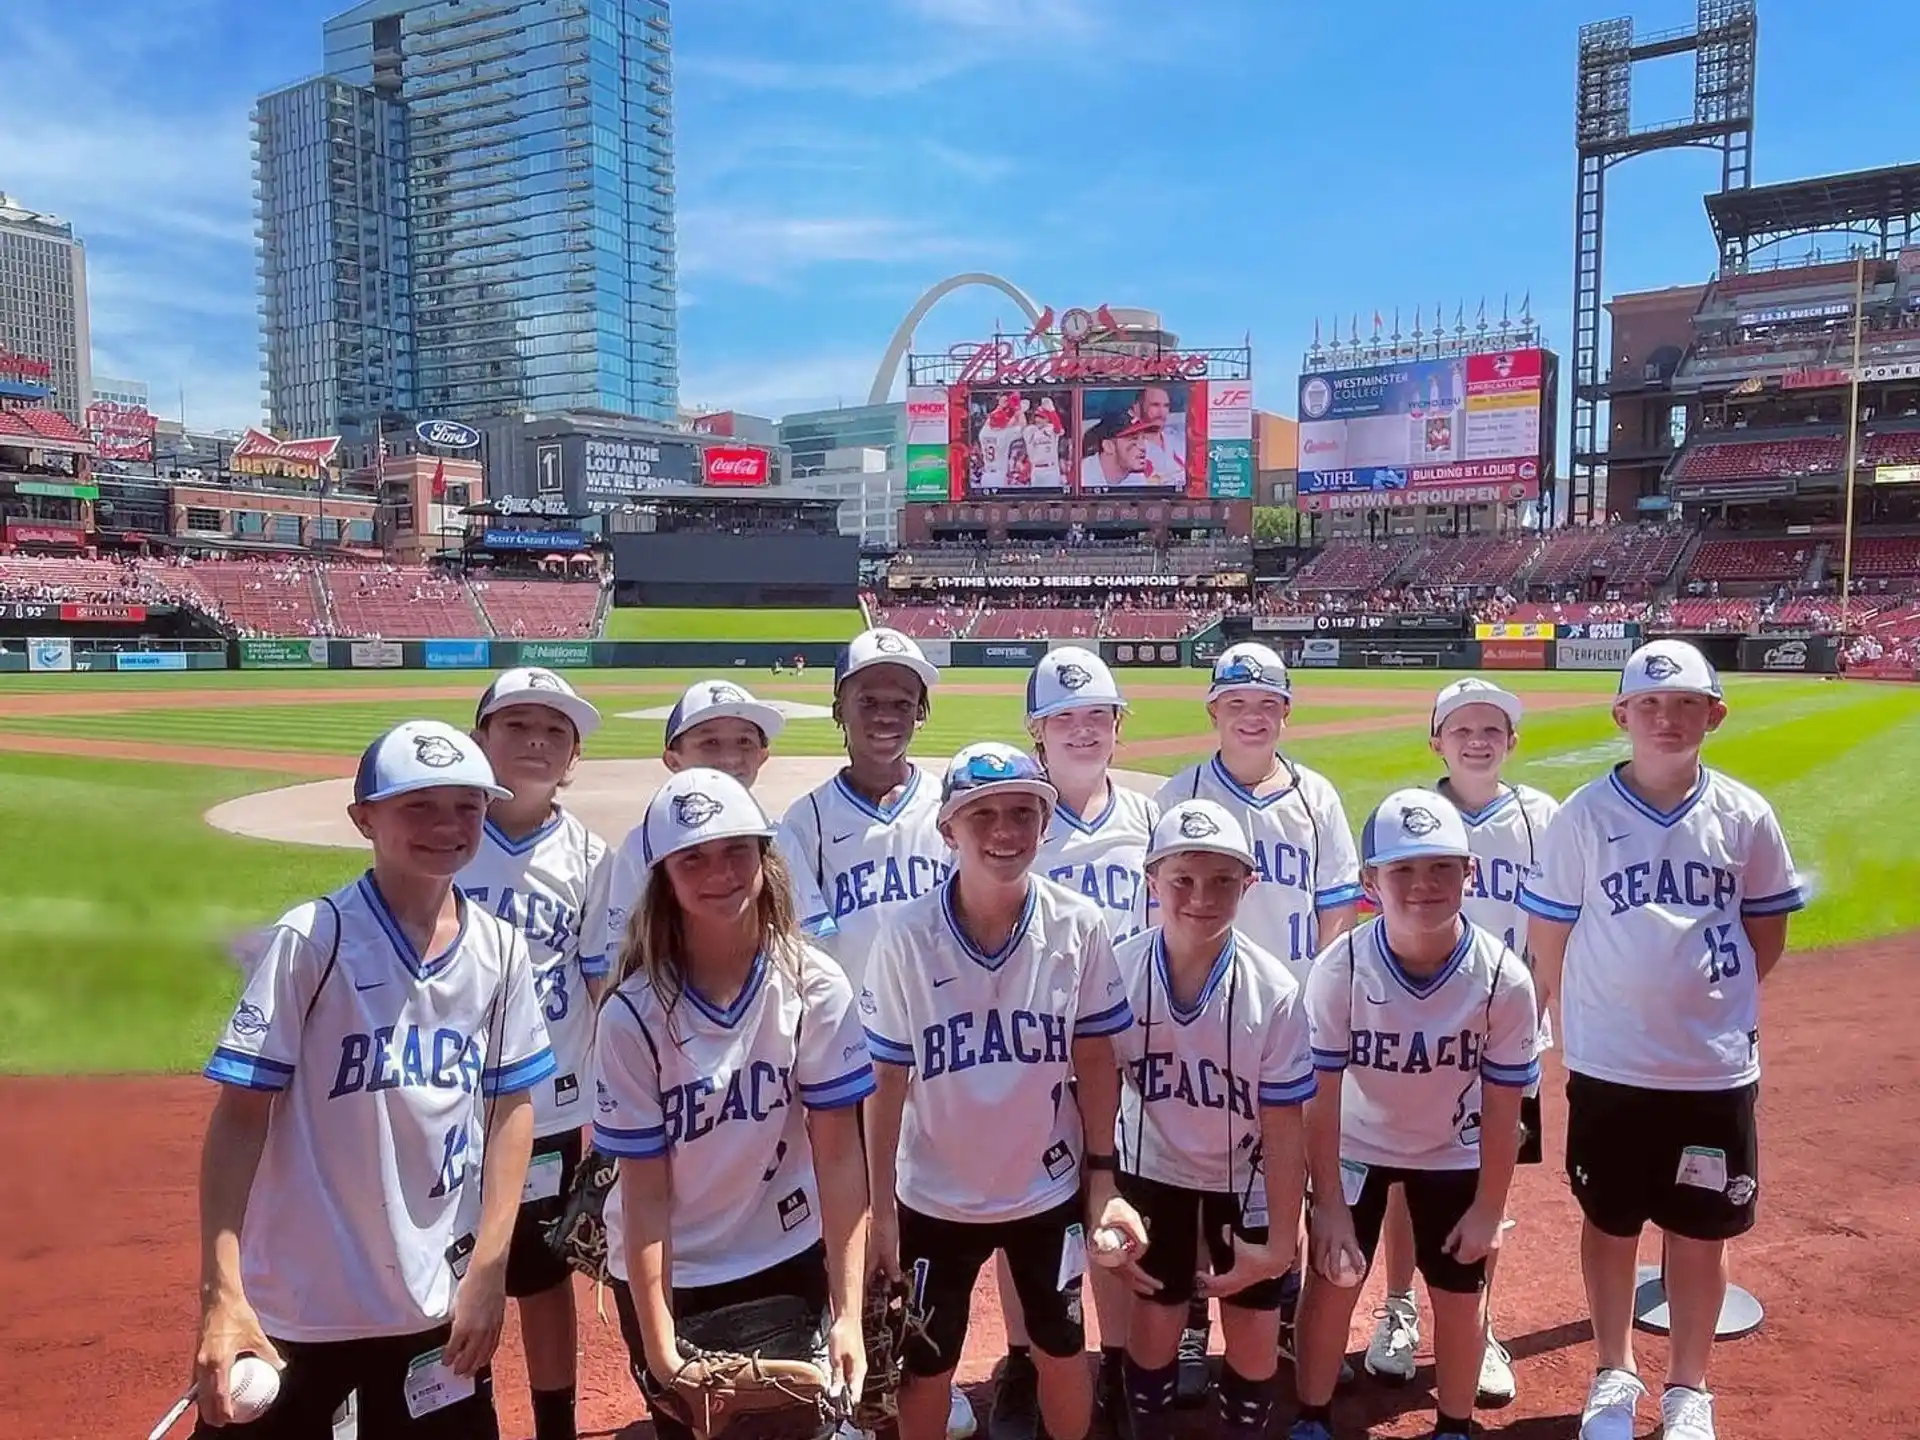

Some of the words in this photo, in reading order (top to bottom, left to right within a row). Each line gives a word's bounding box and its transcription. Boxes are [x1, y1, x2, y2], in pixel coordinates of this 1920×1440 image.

[1864, 365, 1920, 378] POWE
[1333, 386, 1384, 400] COLLEGE
[430, 422, 468, 445] Ford
[585, 441, 630, 459] FROM
[631, 444, 660, 462] THE
[283, 463, 340, 483] HOUE
[586, 457, 617, 473] LOU
[619, 460, 650, 474] AND
[1413, 466, 1463, 481] BUILDING
[1483, 463, 1516, 477] LOUIS
[586, 471, 635, 488] WE'RE
[1313, 470, 1358, 488] STIFEL
[1329, 493, 1391, 510] BROWN
[1407, 486, 1501, 505] CROUPPEN
[937, 577, 986, 588] 11-TIME
[988, 577, 1040, 587] WORLD
[1043, 576, 1092, 587] SERIES
[1094, 575, 1179, 587] CHAMPIONS
[537, 645, 588, 658] National
[1600, 859, 1736, 916] BEACH
[1703, 922, 1741, 984] 15
[922, 1008, 1068, 1082] BEACH
[1350, 1028, 1482, 1075] BEACH
